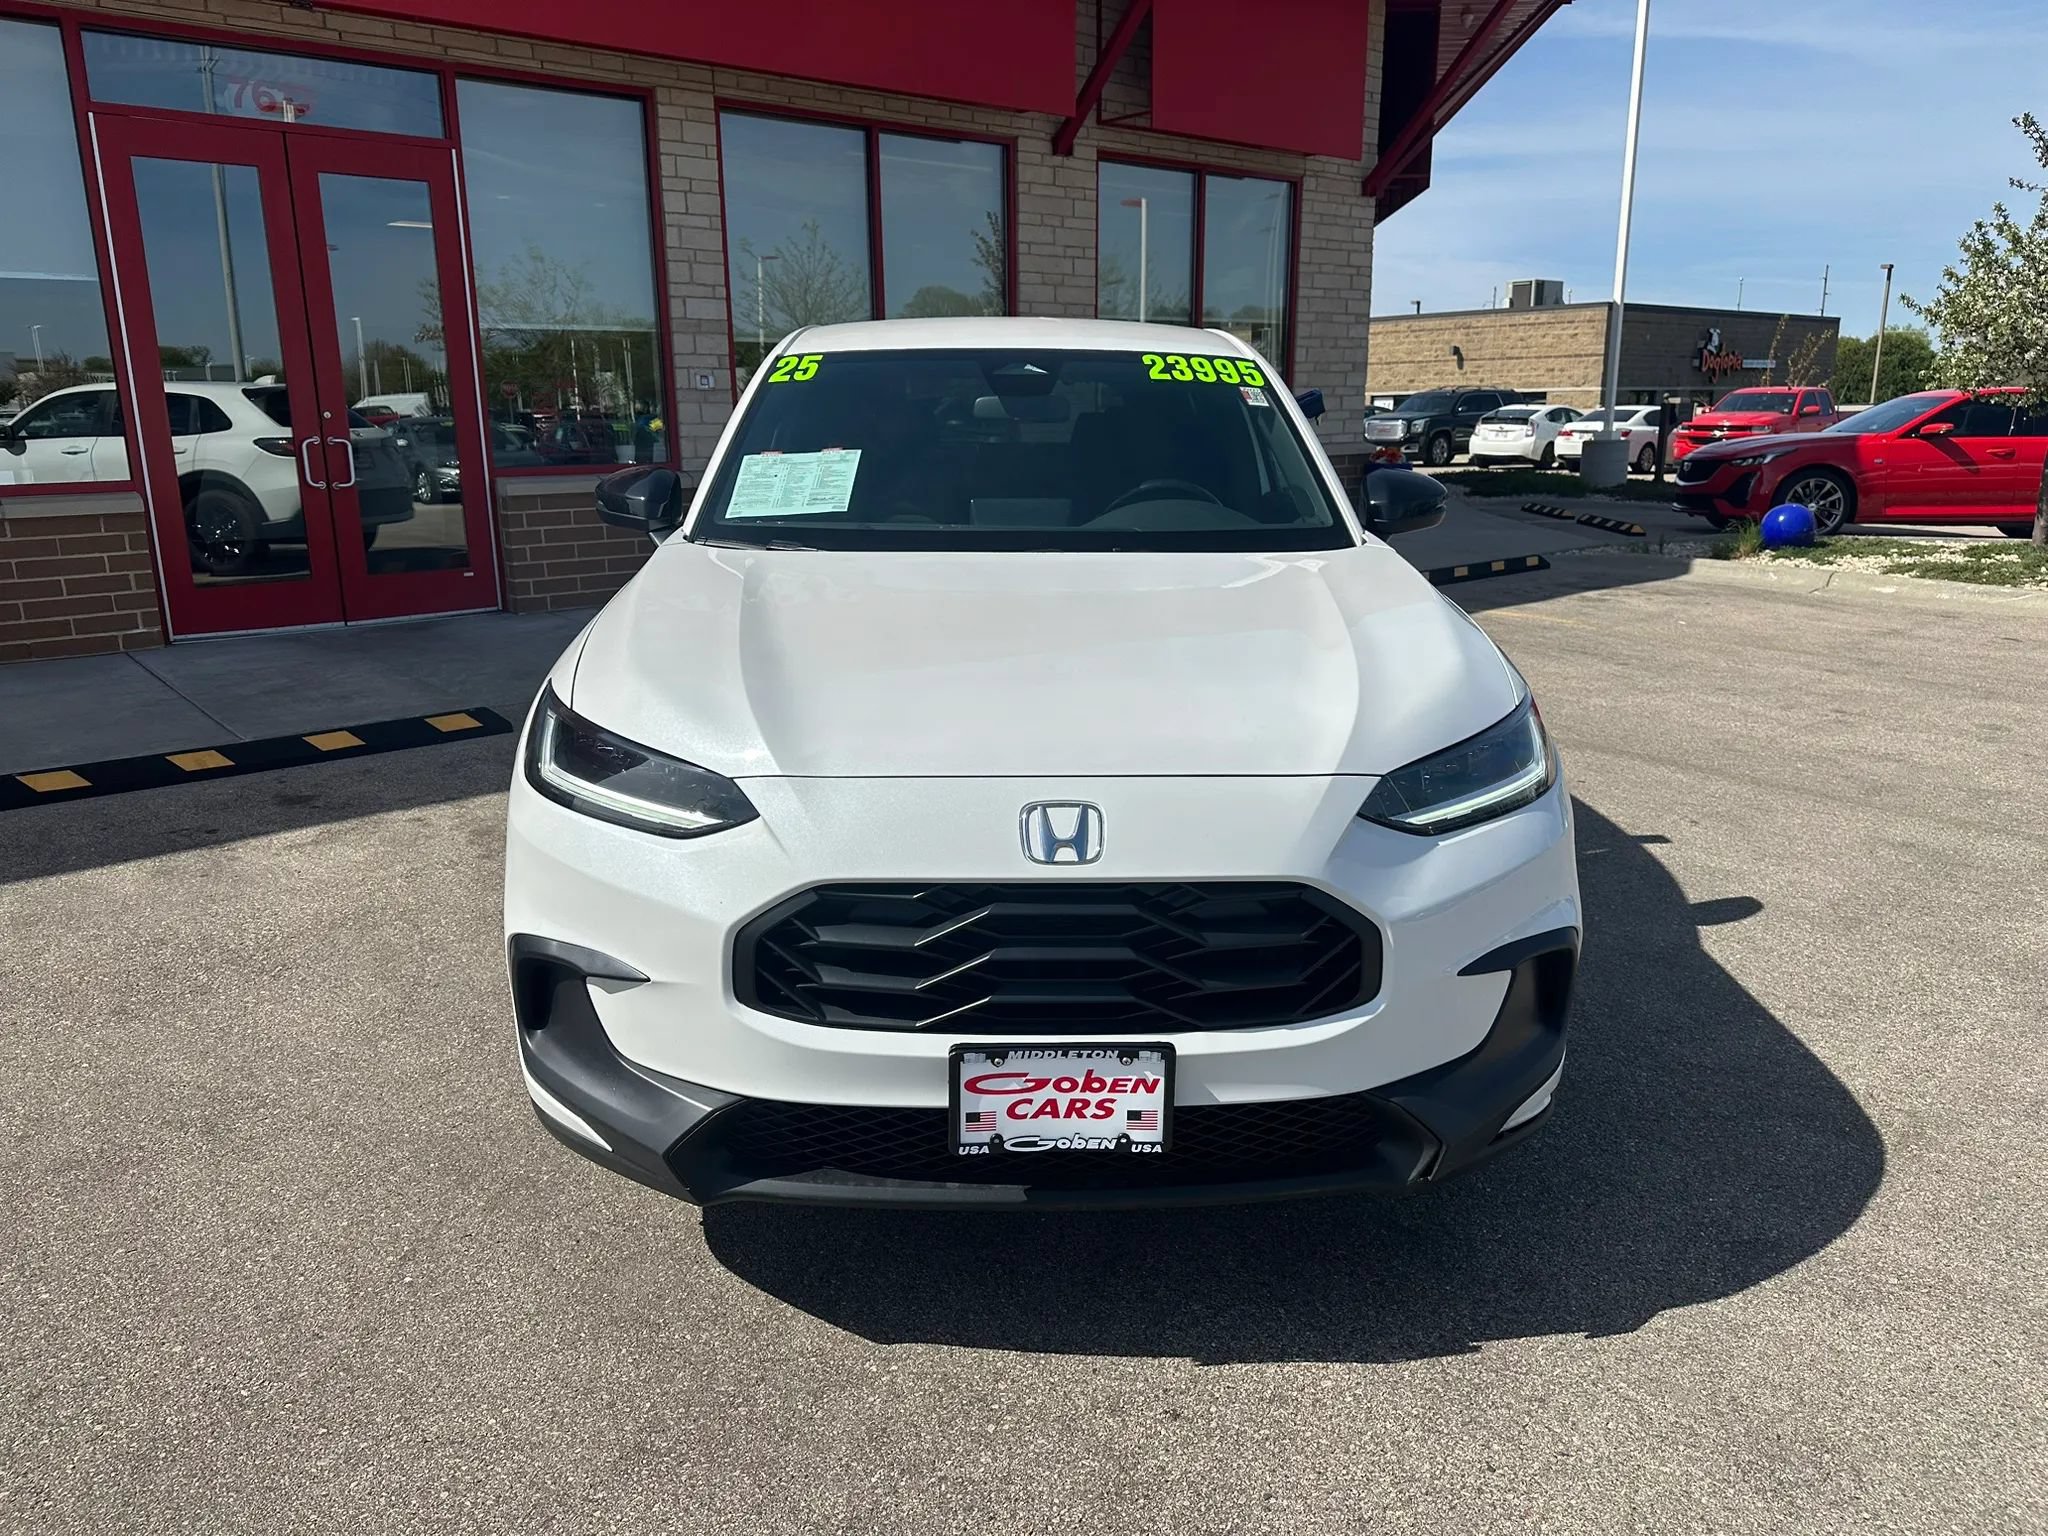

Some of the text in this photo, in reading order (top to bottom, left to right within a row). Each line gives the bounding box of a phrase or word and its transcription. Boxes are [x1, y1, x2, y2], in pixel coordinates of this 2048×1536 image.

[768, 354, 824, 383] 25
[1141, 353, 1265, 387] 23995
[1702, 340, 1742, 384] Dogtopia
[1007, 1050, 1119, 1060] MIDDLETON
[1006, 1097, 1118, 1120] CARS
[958, 1145, 990, 1155] USA
[1131, 1143, 1163, 1153] USA
